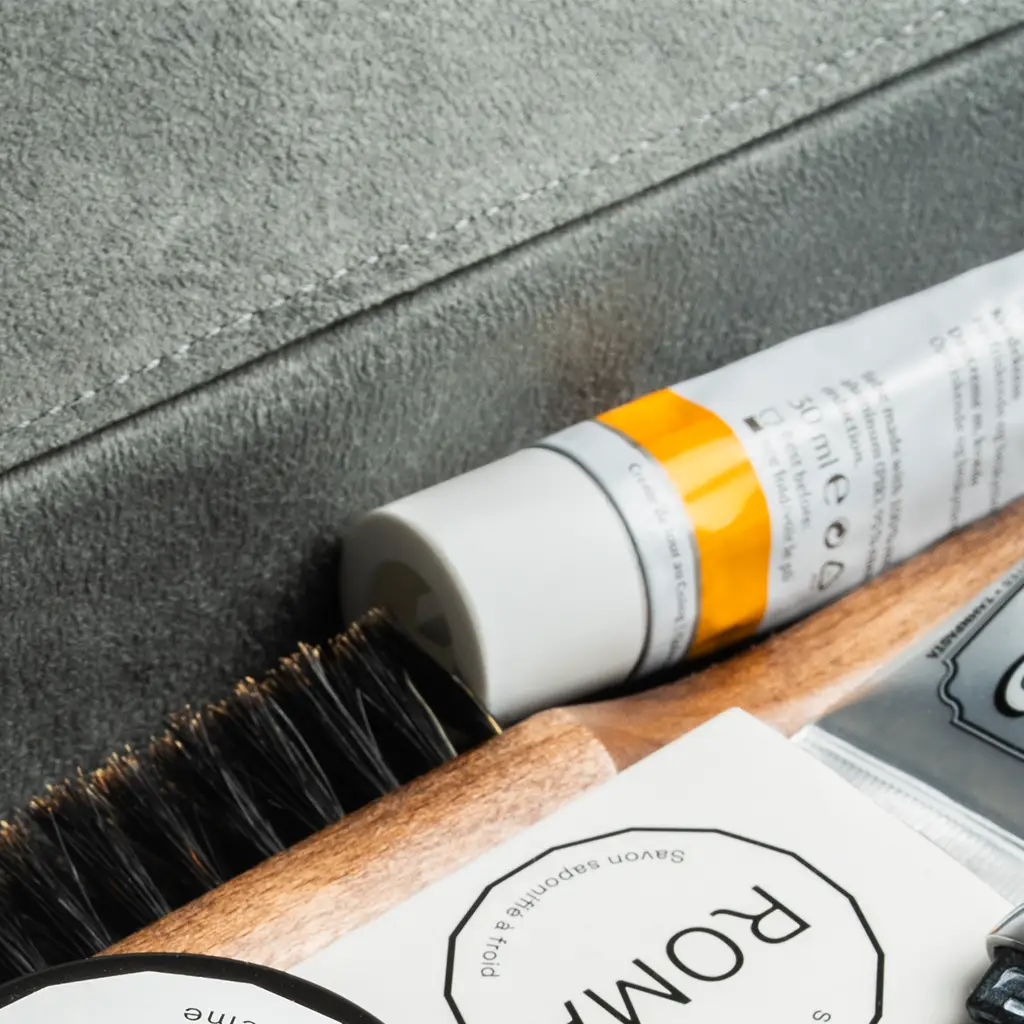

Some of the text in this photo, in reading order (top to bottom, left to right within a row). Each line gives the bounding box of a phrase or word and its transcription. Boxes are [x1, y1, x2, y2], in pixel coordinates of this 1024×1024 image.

[811, 433, 839, 470] ml
[480, 848, 685, 978] Savon saponifié à froid
